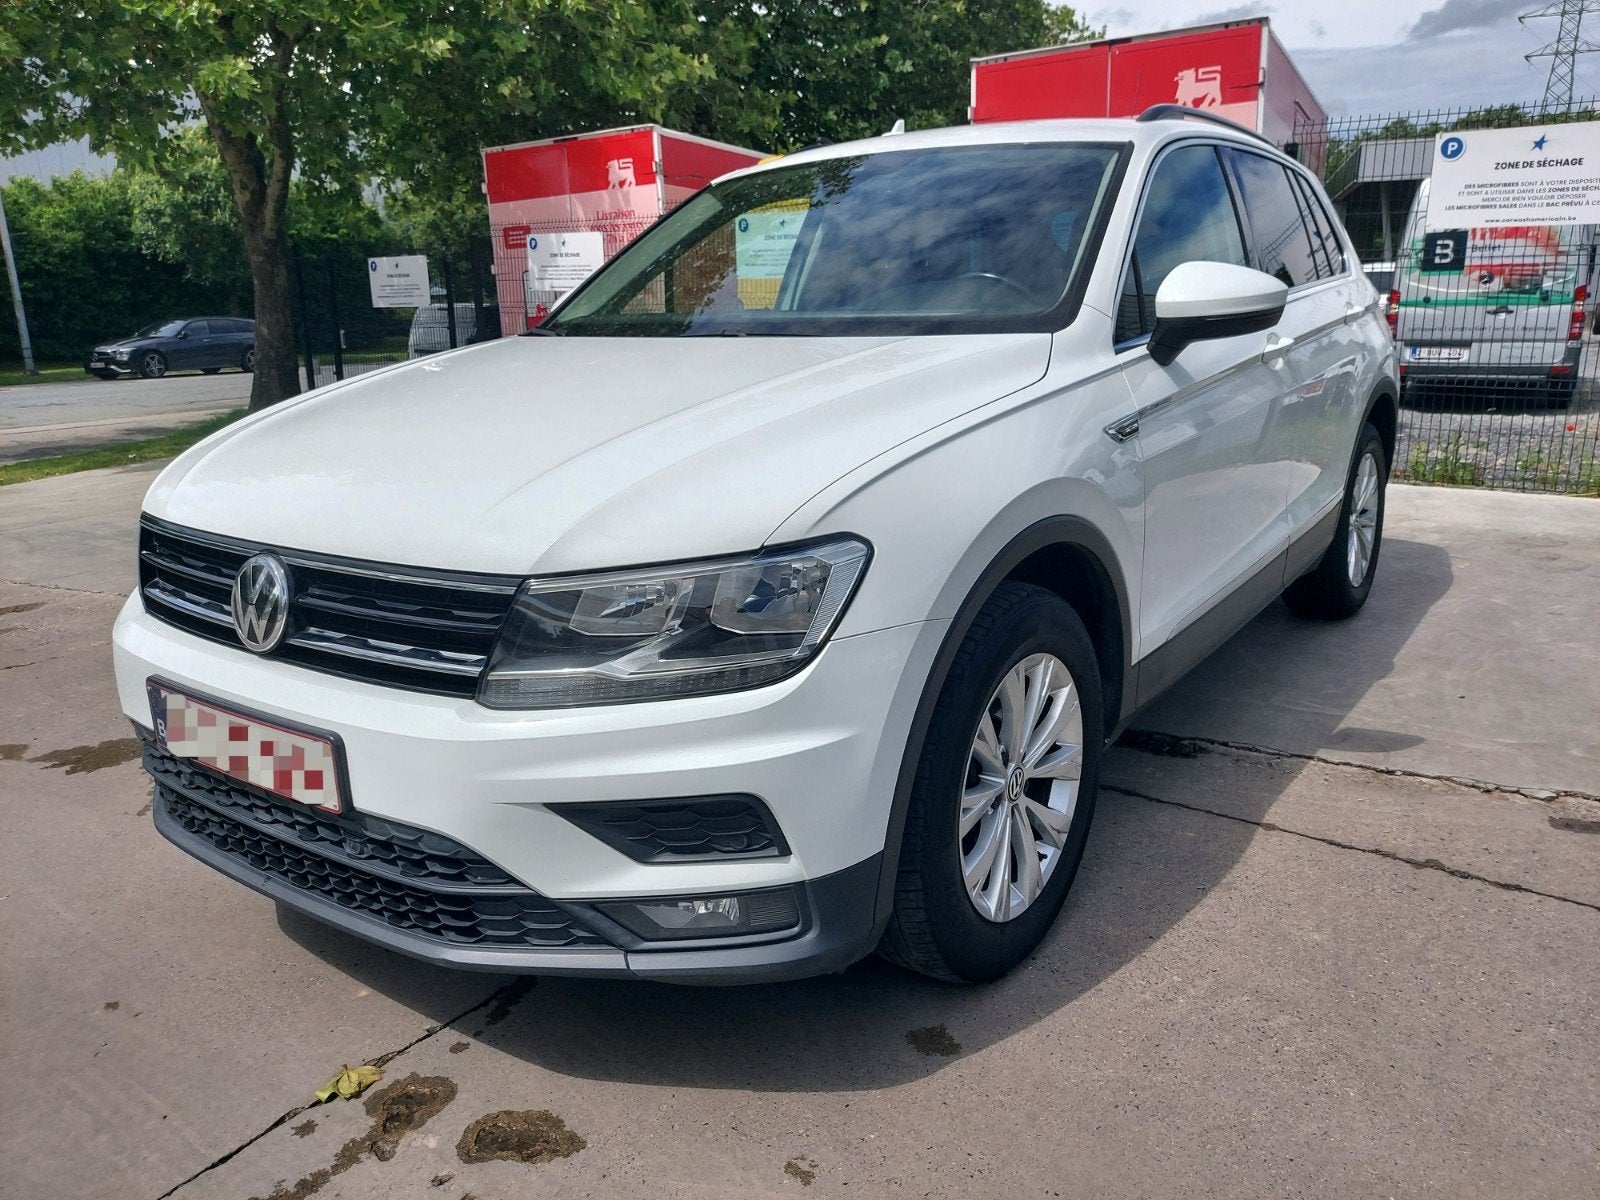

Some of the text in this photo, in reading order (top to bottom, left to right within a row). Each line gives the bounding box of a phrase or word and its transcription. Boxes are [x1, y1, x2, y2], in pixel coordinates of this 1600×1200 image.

[1447, 142, 1458, 156] P
[1494, 157, 1584, 170] ZONE DE SÉCHAGE
